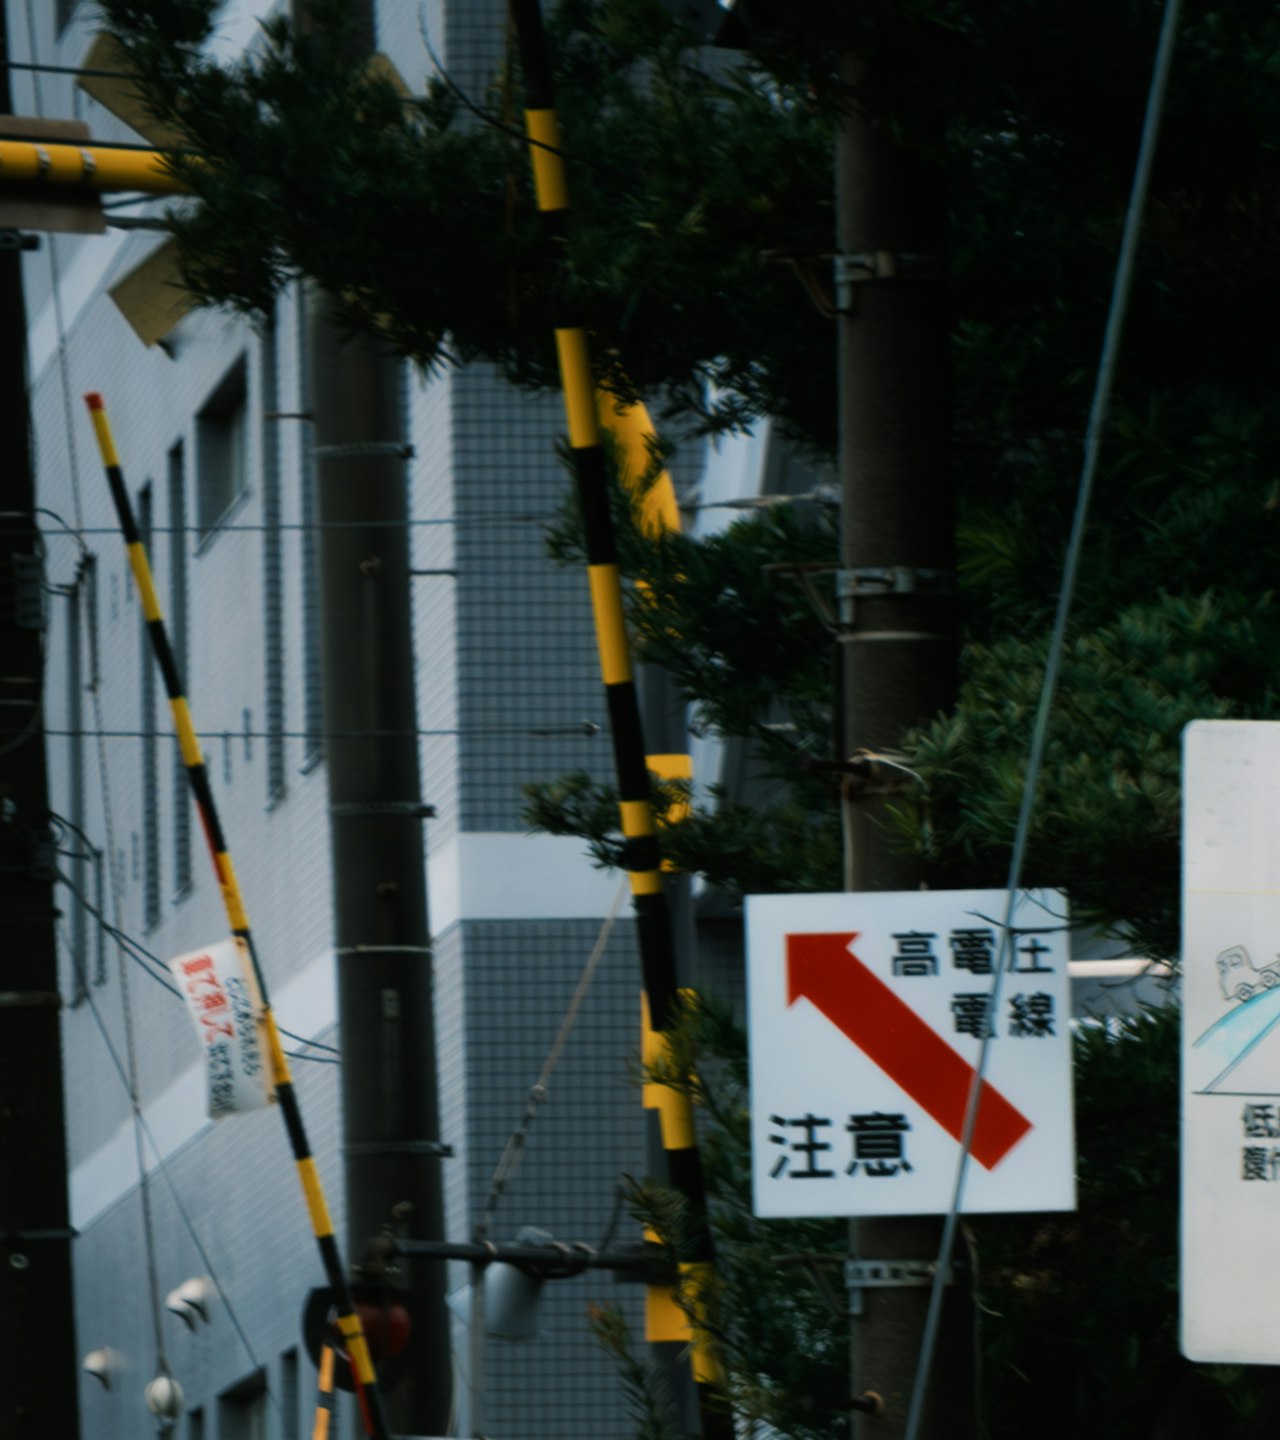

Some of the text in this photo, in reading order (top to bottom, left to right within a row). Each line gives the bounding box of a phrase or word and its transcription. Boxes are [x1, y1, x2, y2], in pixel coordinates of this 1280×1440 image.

[890, 927, 1055, 977] 高電圧
[950, 993, 1058, 1040] 電線
[767, 1111, 914, 1180] 注意
